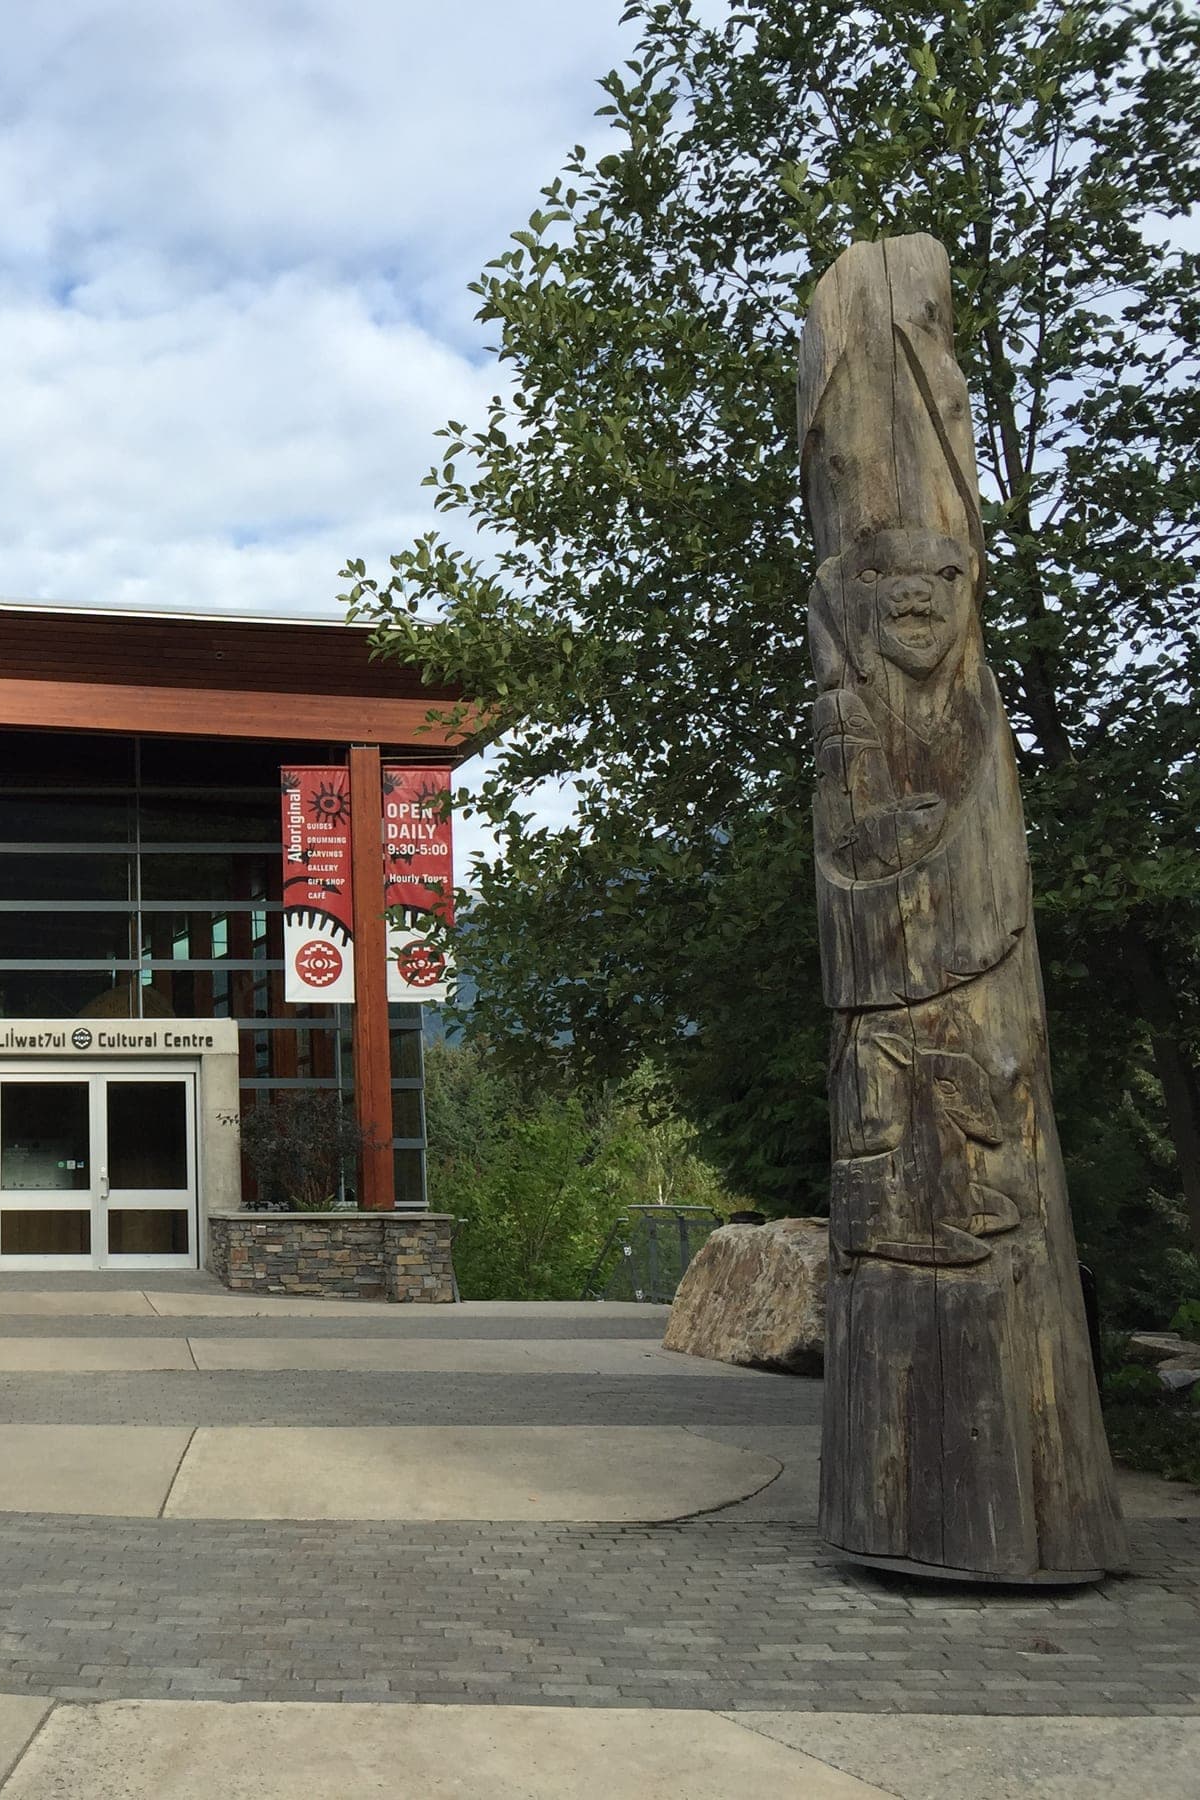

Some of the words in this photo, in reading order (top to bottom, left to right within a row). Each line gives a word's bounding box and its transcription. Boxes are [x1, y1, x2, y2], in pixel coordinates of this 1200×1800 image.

[387, 803, 433, 819] OPEN
[286, 789, 305, 863] Aboriginal
[387, 823, 437, 840] DAILY
[307, 850, 343, 858] CARVINGS
[387, 844, 448, 856] 9:30-5:00
[308, 864, 339, 872] GALLERY
[308, 878, 324, 886] GIFT
[326, 878, 345, 886] SHOP
[389, 873, 420, 885] Hourly
[308, 891, 326, 899] CAFÉ
[98, 1032, 157, 1048] Cultural
[165, 1032, 214, 1048] Centre
